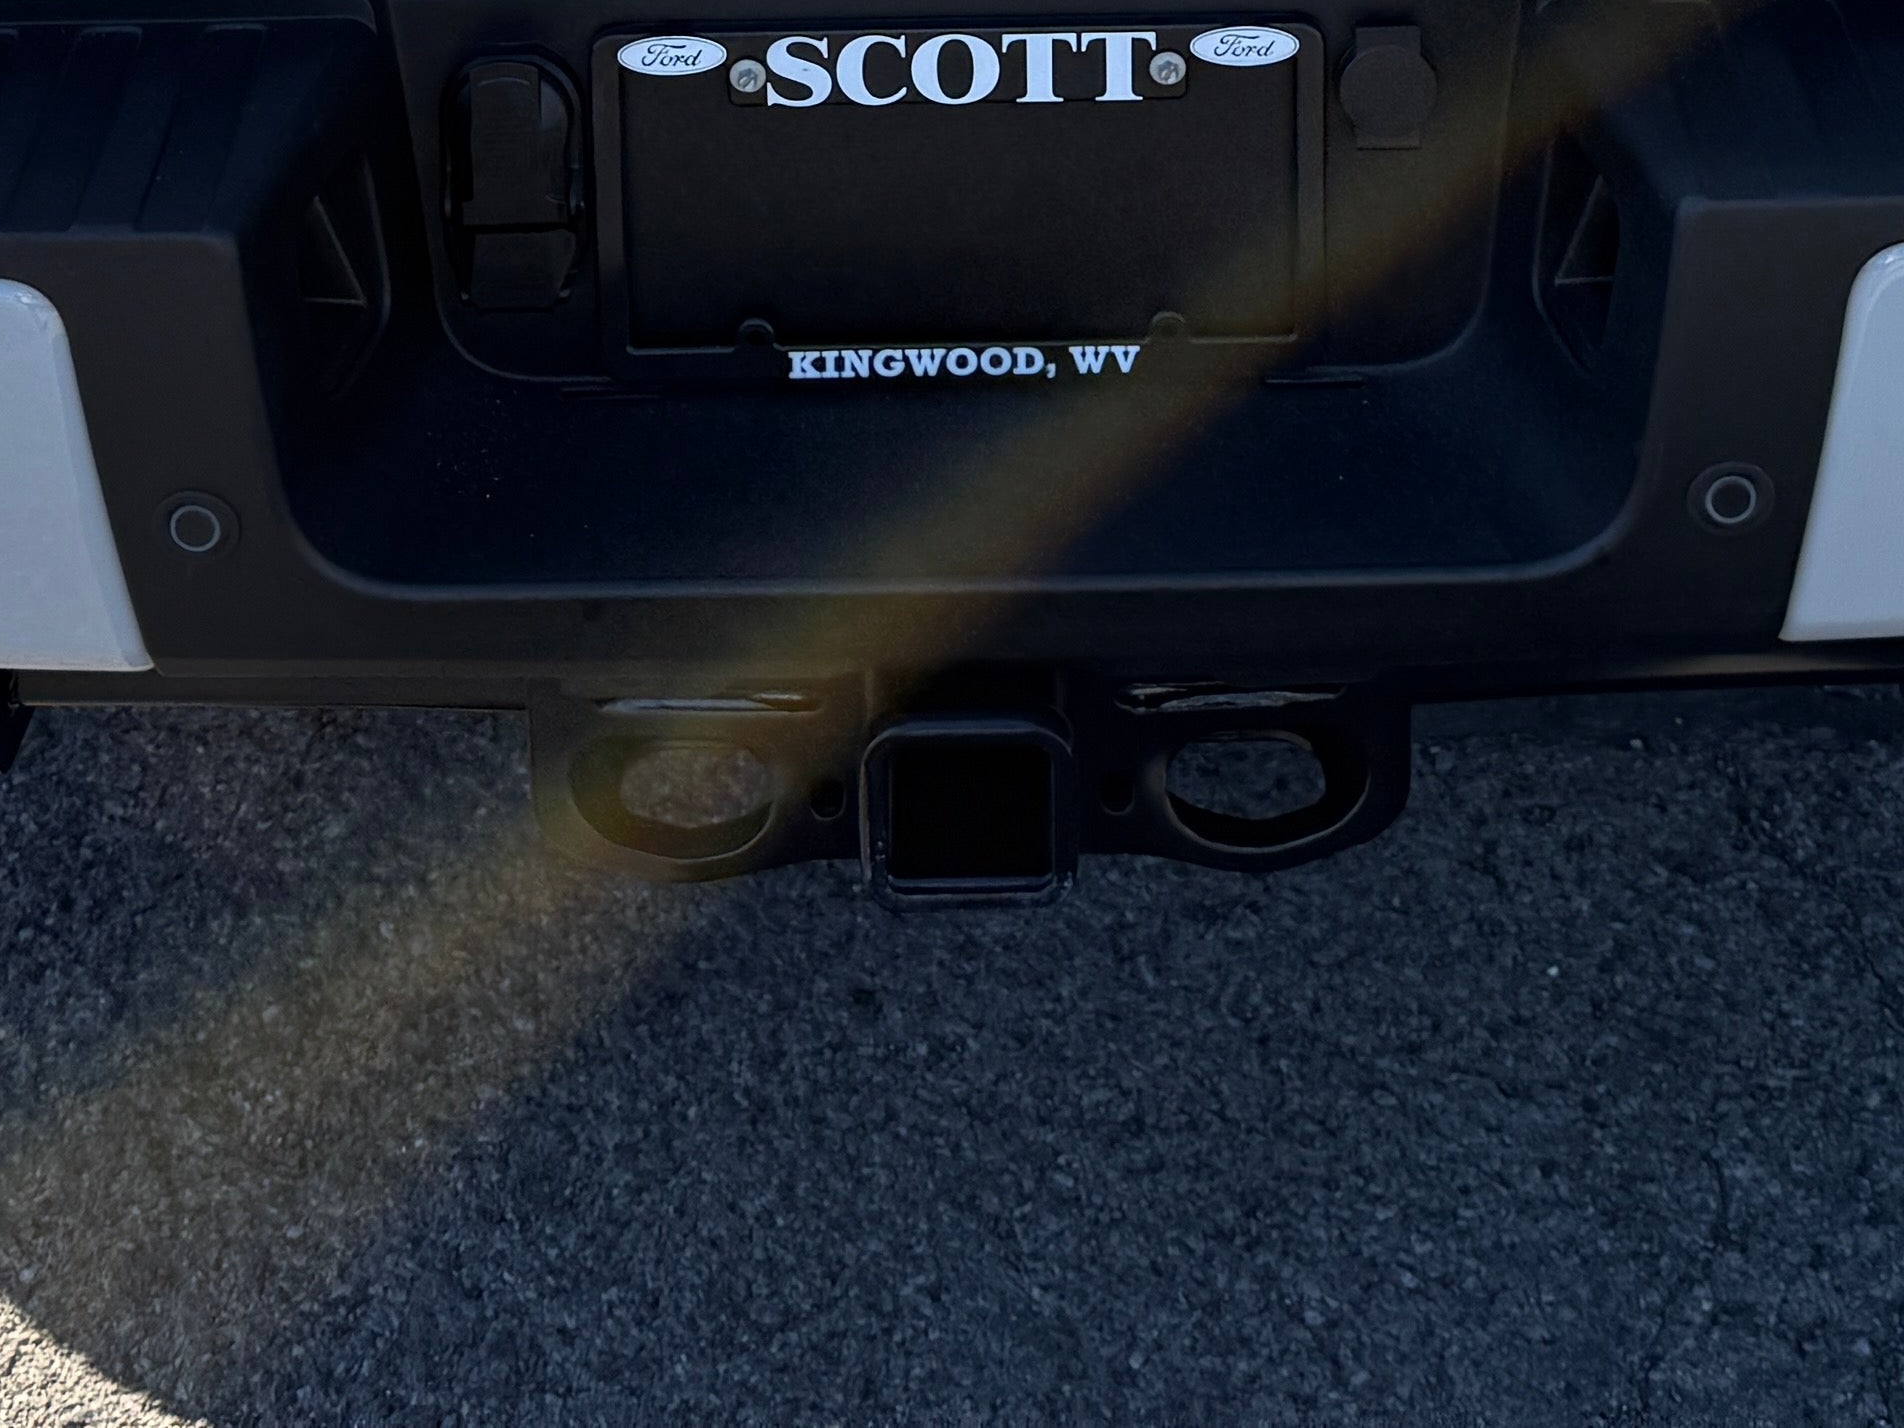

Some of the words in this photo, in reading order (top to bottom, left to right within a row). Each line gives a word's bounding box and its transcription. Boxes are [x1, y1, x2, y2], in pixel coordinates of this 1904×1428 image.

[641, 43, 703, 68] Ford
[1213, 33, 1275, 58] Ford
[765, 31, 1157, 107] SCOTT
[788, 346, 1056, 379] KINGWOOD,
[1068, 344, 1141, 375] WV
